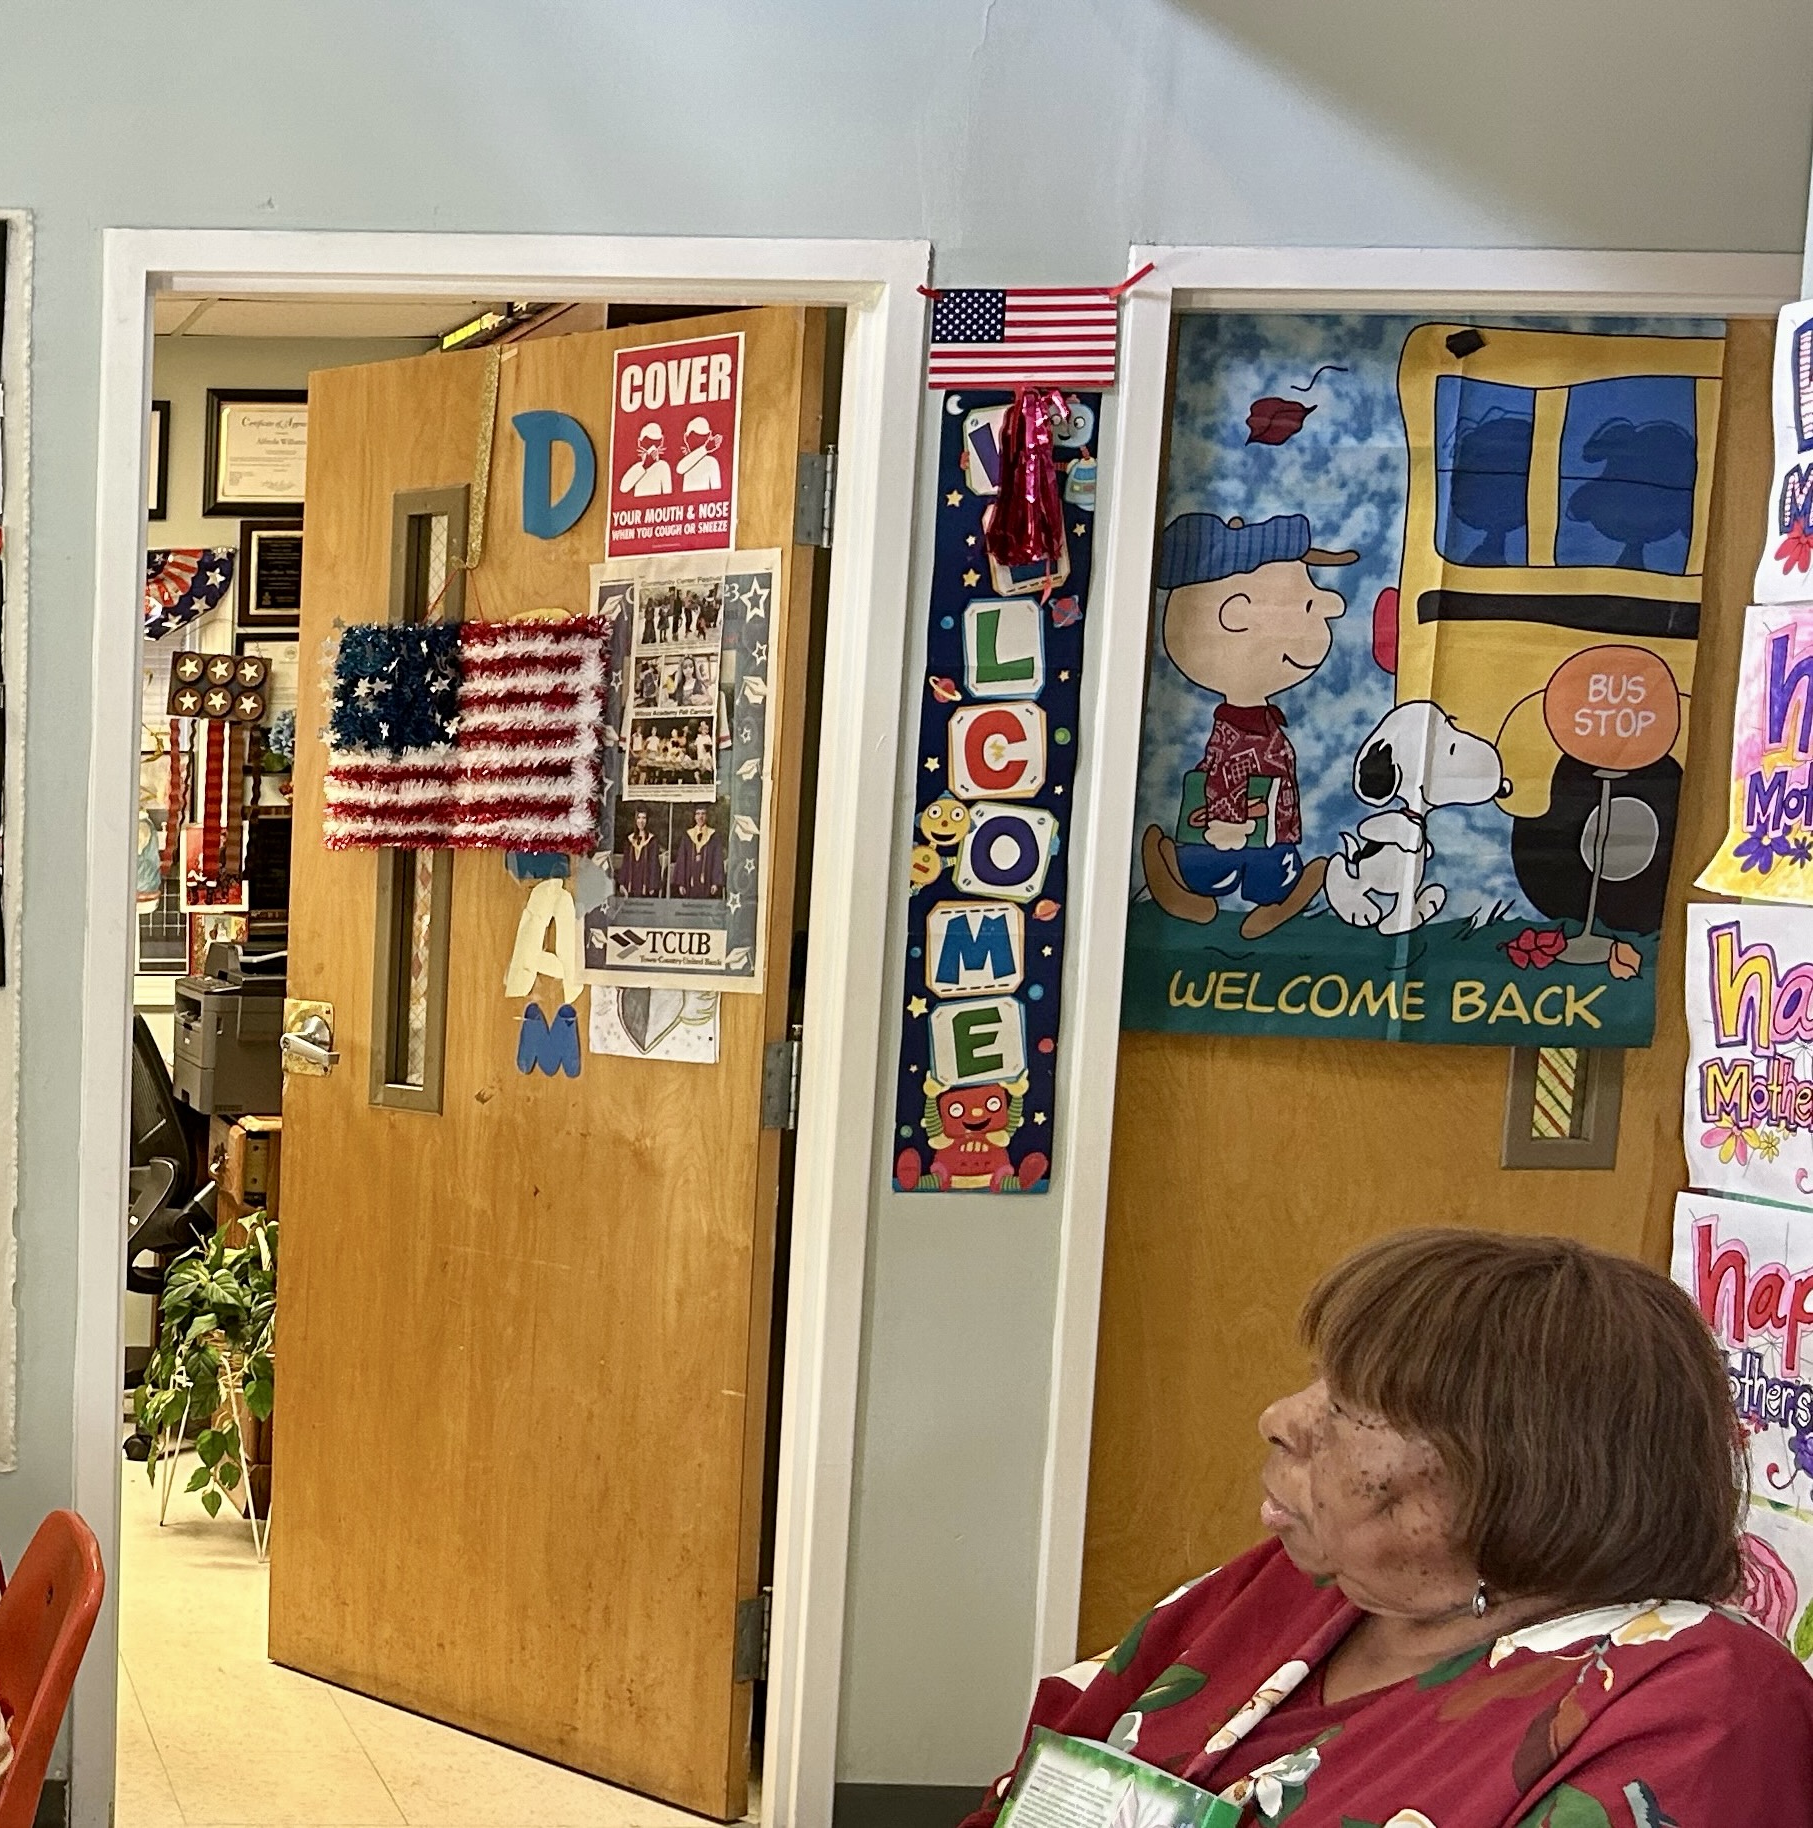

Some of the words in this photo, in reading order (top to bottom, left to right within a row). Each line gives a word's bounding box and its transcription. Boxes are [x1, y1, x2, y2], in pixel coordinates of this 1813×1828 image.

[620, 353, 732, 413] COVER
[612, 510, 642, 526] YOUR
[645, 506, 683, 524] MOUTH
[686, 505, 695, 520] &
[699, 501, 729, 519] NOSE
[612, 528, 634, 541] WHEN
[637, 527, 653, 539] YOU
[655, 524, 682, 537] COUGH
[684, 522, 695, 534] OR
[698, 520, 728, 533] SNEEZE
[1587, 674, 1649, 705] BUS
[1574, 708, 1657, 738] STOP
[646, 931, 711, 955] TCUB
[1168, 970, 1426, 1022] WELCOME
[1452, 980, 1608, 1029] BACK
